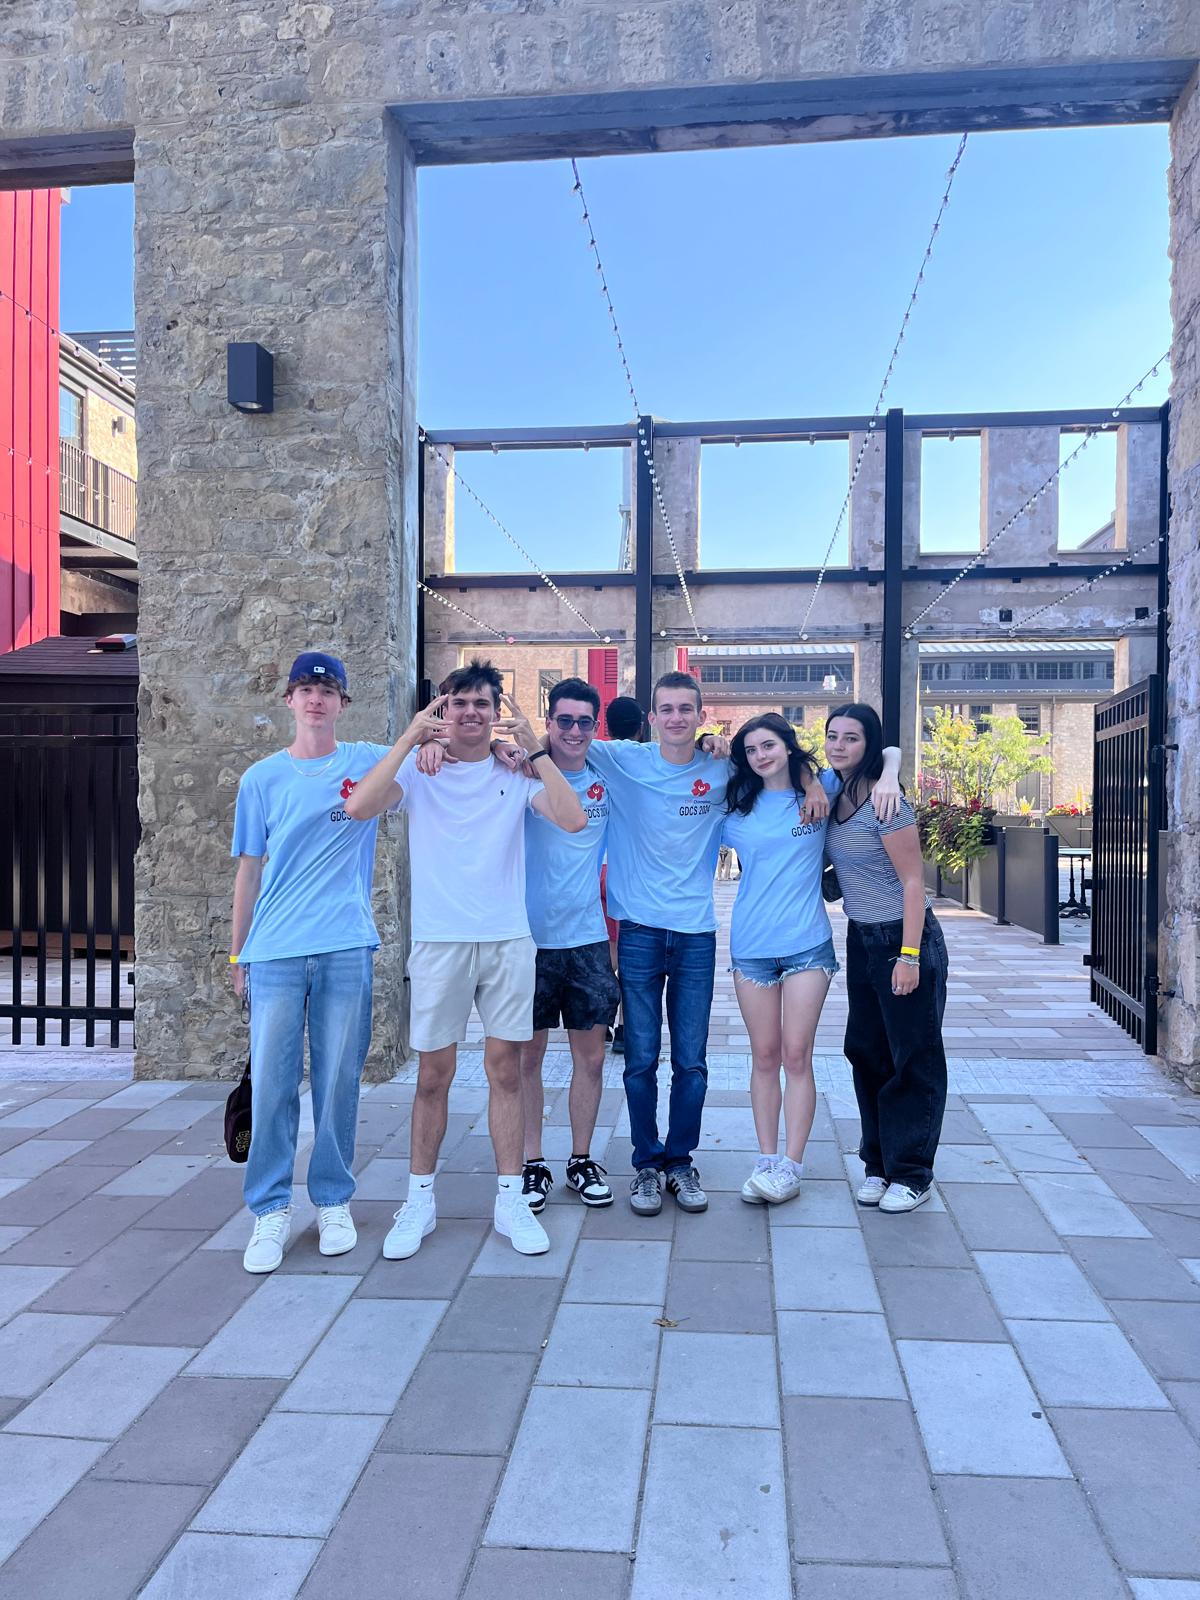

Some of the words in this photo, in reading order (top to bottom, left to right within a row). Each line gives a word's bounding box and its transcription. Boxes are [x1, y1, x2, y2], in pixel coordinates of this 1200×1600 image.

[584, 808, 600, 818] DCS
[680, 806, 698, 816] GDCS
[791, 825, 811, 837] GDCS
